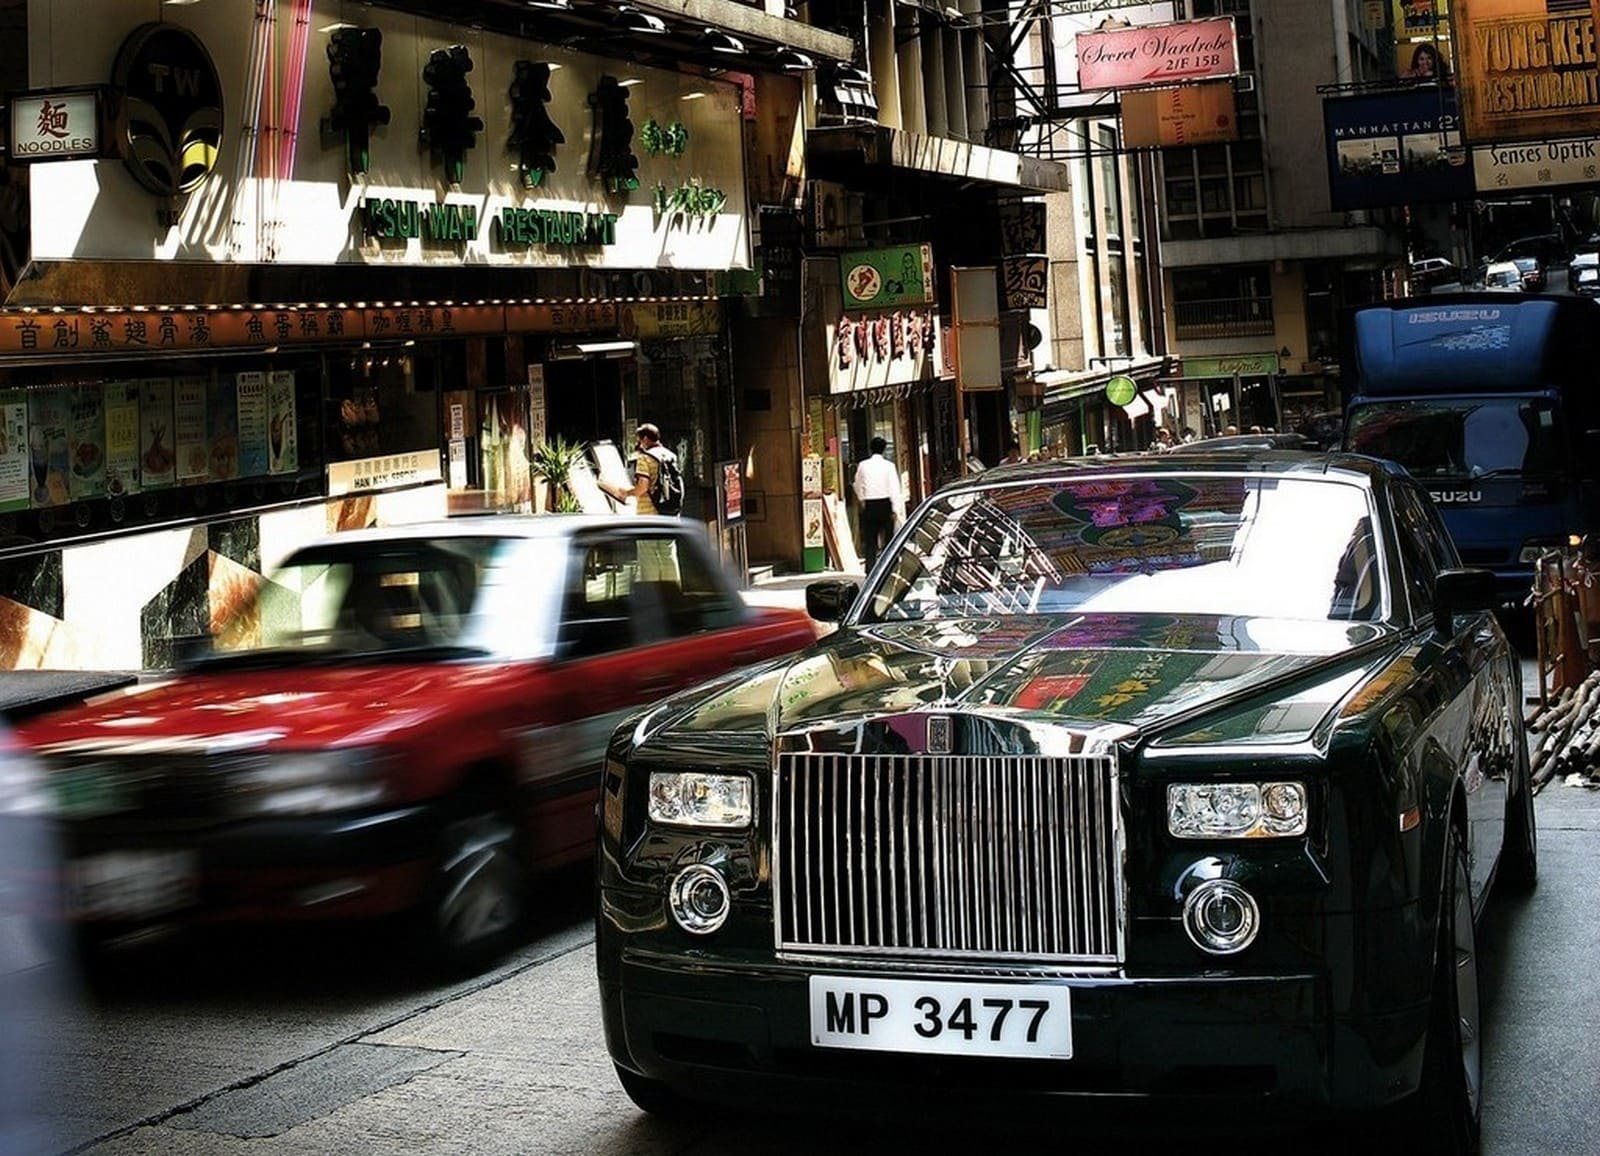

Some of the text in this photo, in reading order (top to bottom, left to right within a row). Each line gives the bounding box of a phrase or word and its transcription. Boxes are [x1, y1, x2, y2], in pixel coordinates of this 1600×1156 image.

[1082, 29, 1230, 65] Secret Wardrobe
[1474, 18, 1597, 72] YUNG KEE
[1166, 55, 1220, 71] 2/F 15B
[1481, 69, 1599, 113] RESTAURANT
[37, 100, 70, 138] 麵
[1335, 121, 1432, 137] MANHATTAN
[17, 137, 93, 152] NOODLES
[1490, 147, 1541, 166] Senses
[1548, 141, 1596, 163] Optik
[429, 202, 477, 241] WAH
[1408, 309, 1501, 324] ISUZU
[1428, 490, 1483, 504] SUZU
[826, 991, 1050, 1042] MP 3477
